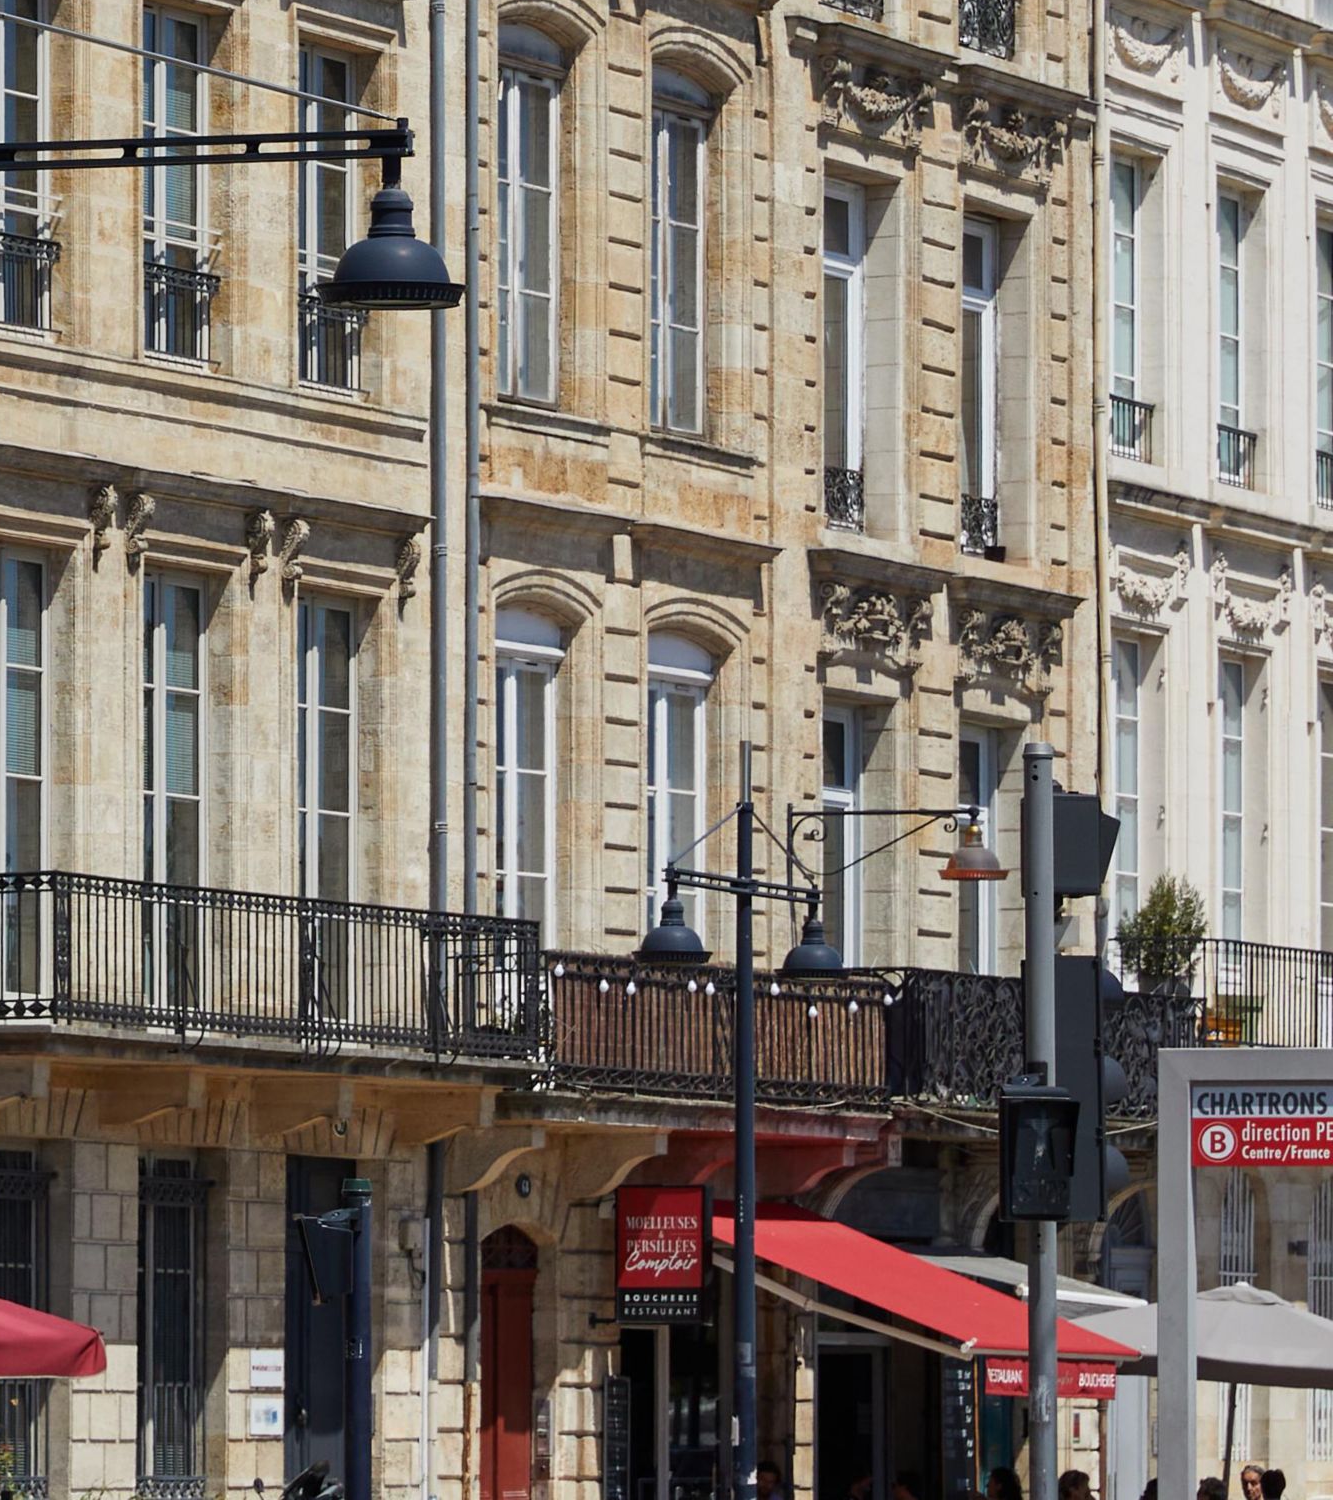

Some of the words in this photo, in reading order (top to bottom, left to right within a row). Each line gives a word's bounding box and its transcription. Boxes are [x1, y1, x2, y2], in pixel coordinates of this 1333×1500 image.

[1196, 1091, 1328, 1116] CHARTRONS
[1209, 1130, 1227, 1154] B
[1241, 1120, 1310, 1142] direction
[1241, 1144, 1331, 1162] Centre/France
[626, 1215, 698, 1229] MOELLEUSES
[625, 1247, 698, 1278] Comptoir
[624, 1293, 698, 1302] BOUCHERIE
[624, 1307, 698, 1316] RESTAURANT
[1078, 1372, 1116, 1388] BOUCHERIE
